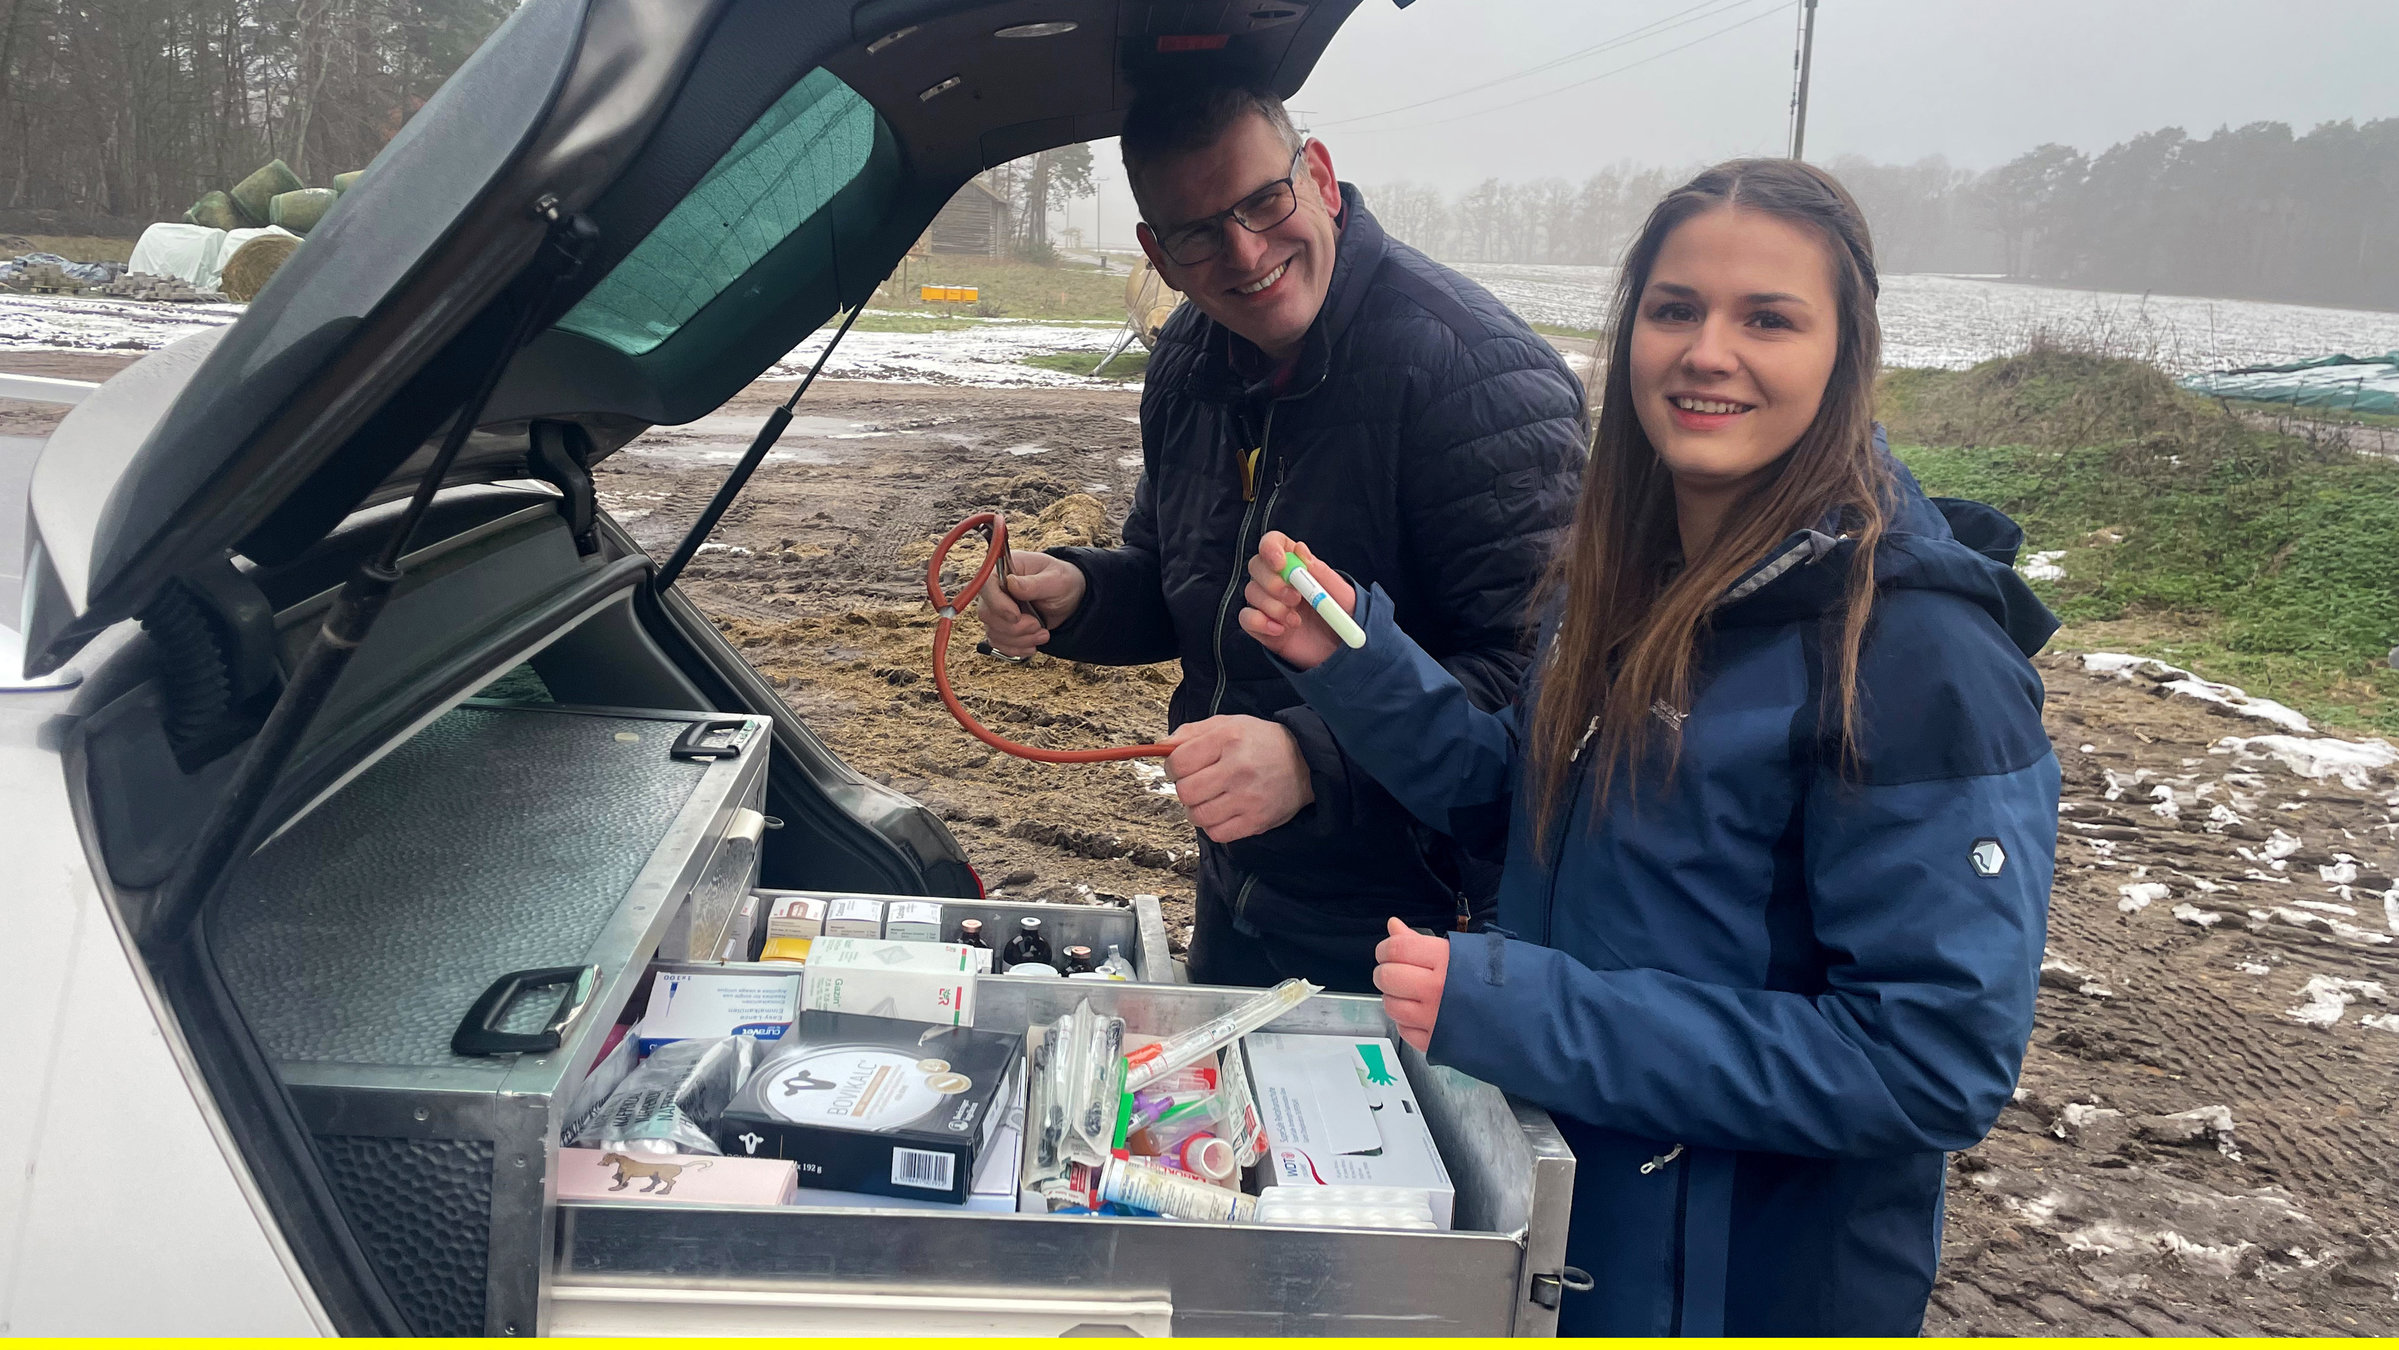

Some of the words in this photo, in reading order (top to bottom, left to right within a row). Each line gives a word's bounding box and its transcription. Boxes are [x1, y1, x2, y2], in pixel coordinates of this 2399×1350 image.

[832, 977, 844, 1005] Gazin
[826, 1059, 878, 1117] BOVIKALC
[802, 1163, 816, 1172] 192
[816, 1166, 822, 1174] g
[1283, 1158, 1298, 1177] WDT
